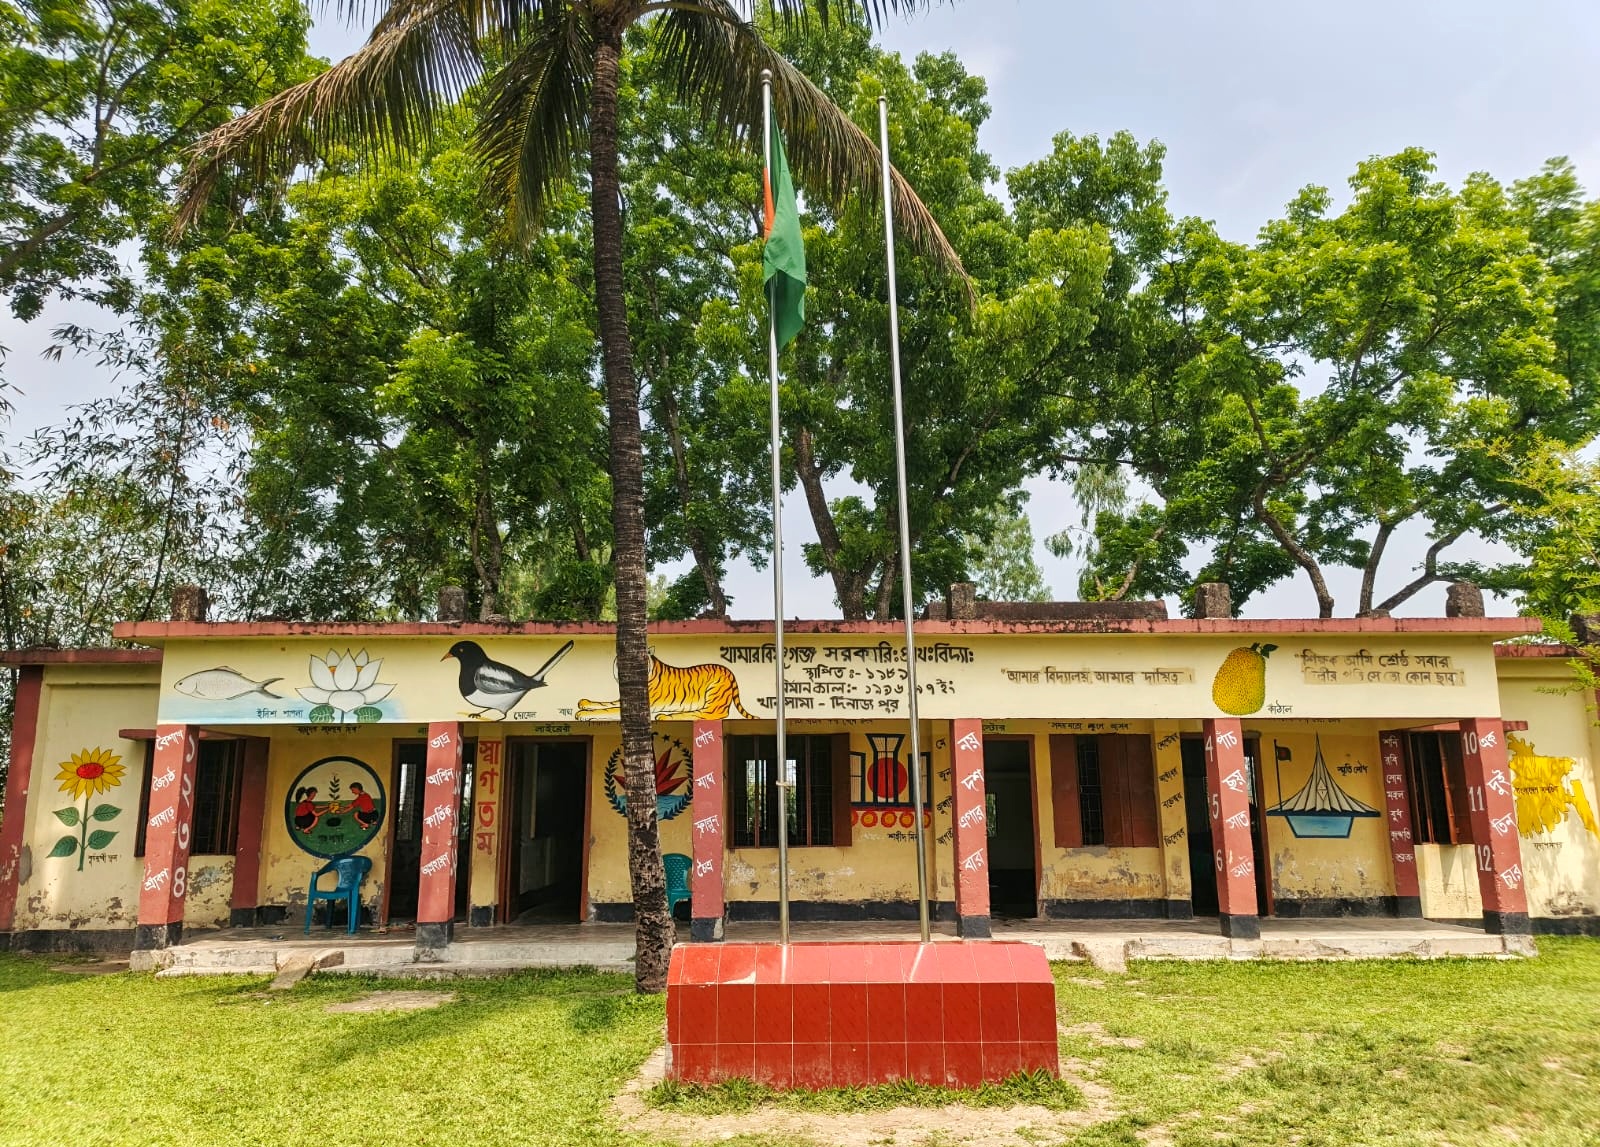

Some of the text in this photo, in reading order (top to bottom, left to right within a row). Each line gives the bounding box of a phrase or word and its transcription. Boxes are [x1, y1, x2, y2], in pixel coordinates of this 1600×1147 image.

[1205, 735, 1214, 762] 4
[1463, 731, 1478, 755] 10
[1212, 793, 1219, 819] 5
[1469, 785, 1484, 812] 11
[1216, 849, 1223, 871] 6
[1477, 844, 1492, 872] 12
